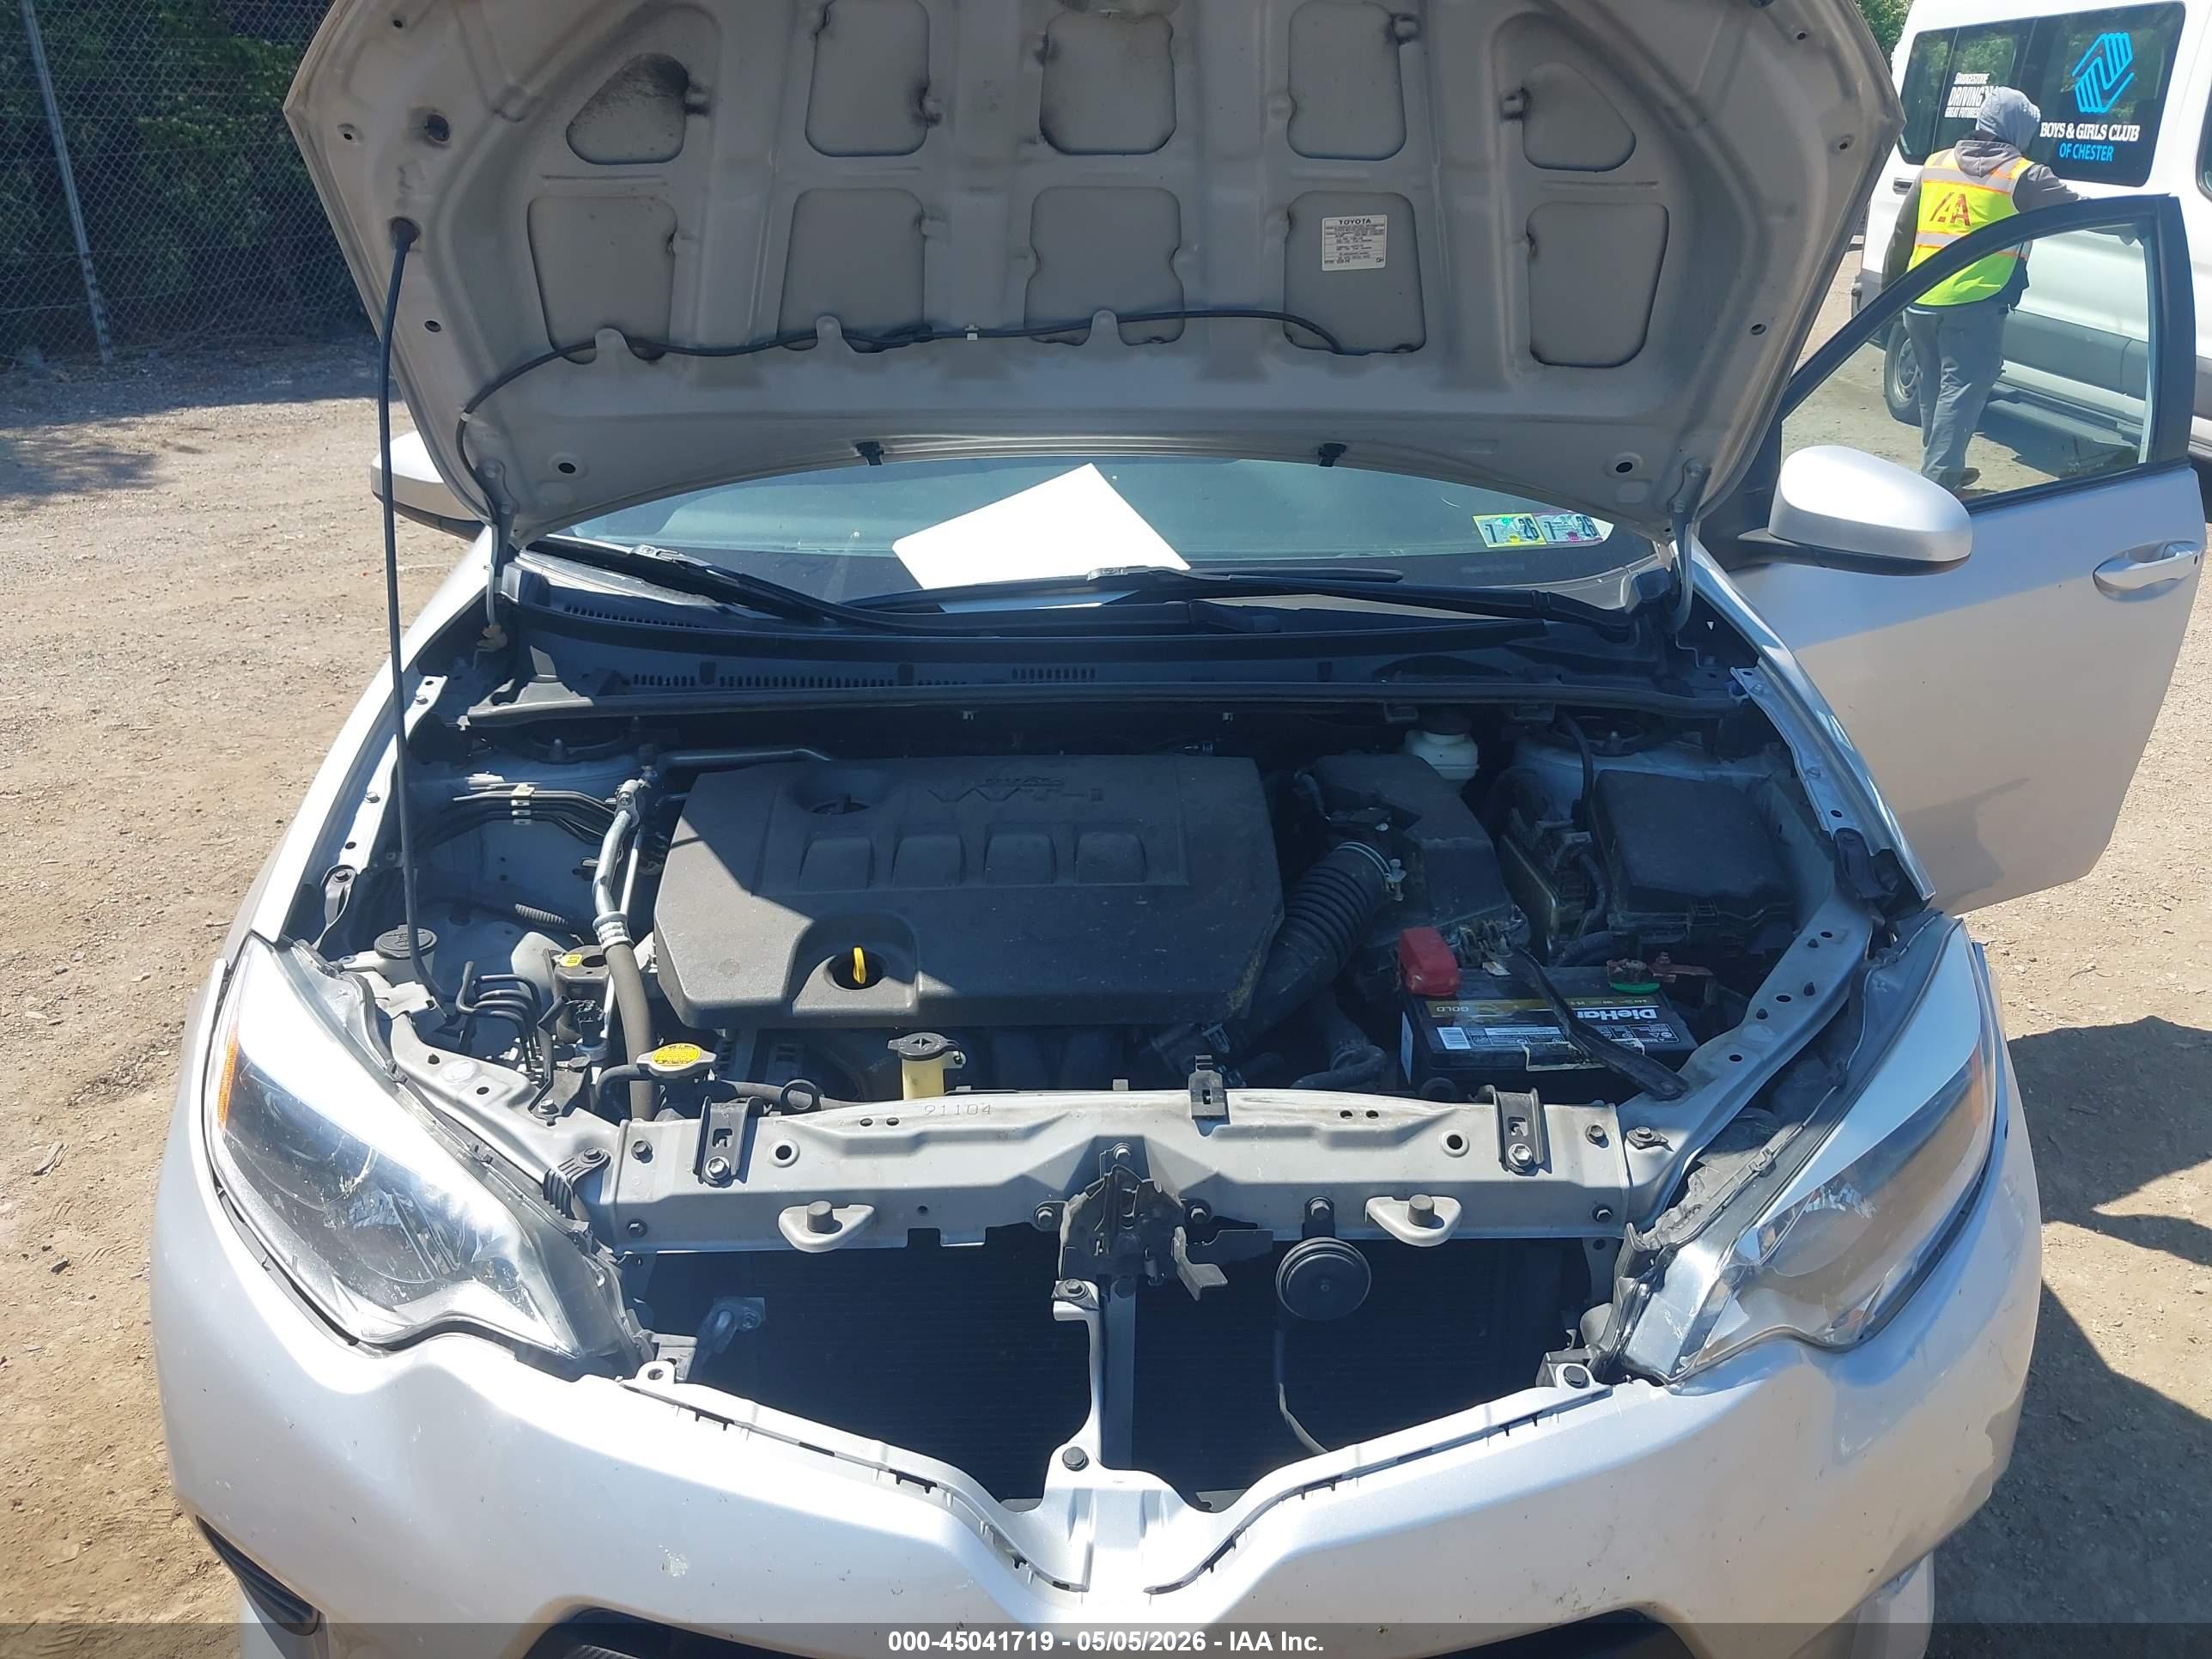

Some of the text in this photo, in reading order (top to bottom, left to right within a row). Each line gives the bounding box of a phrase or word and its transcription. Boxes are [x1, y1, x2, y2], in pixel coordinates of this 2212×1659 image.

[1948, 87, 1985, 106] DRIVING
[2039, 122, 2140, 141] BOYS & GIRLS CLUB
[2059, 143, 2114, 161] OF CHESTER
[1575, 1008, 1658, 1021] DieHar
